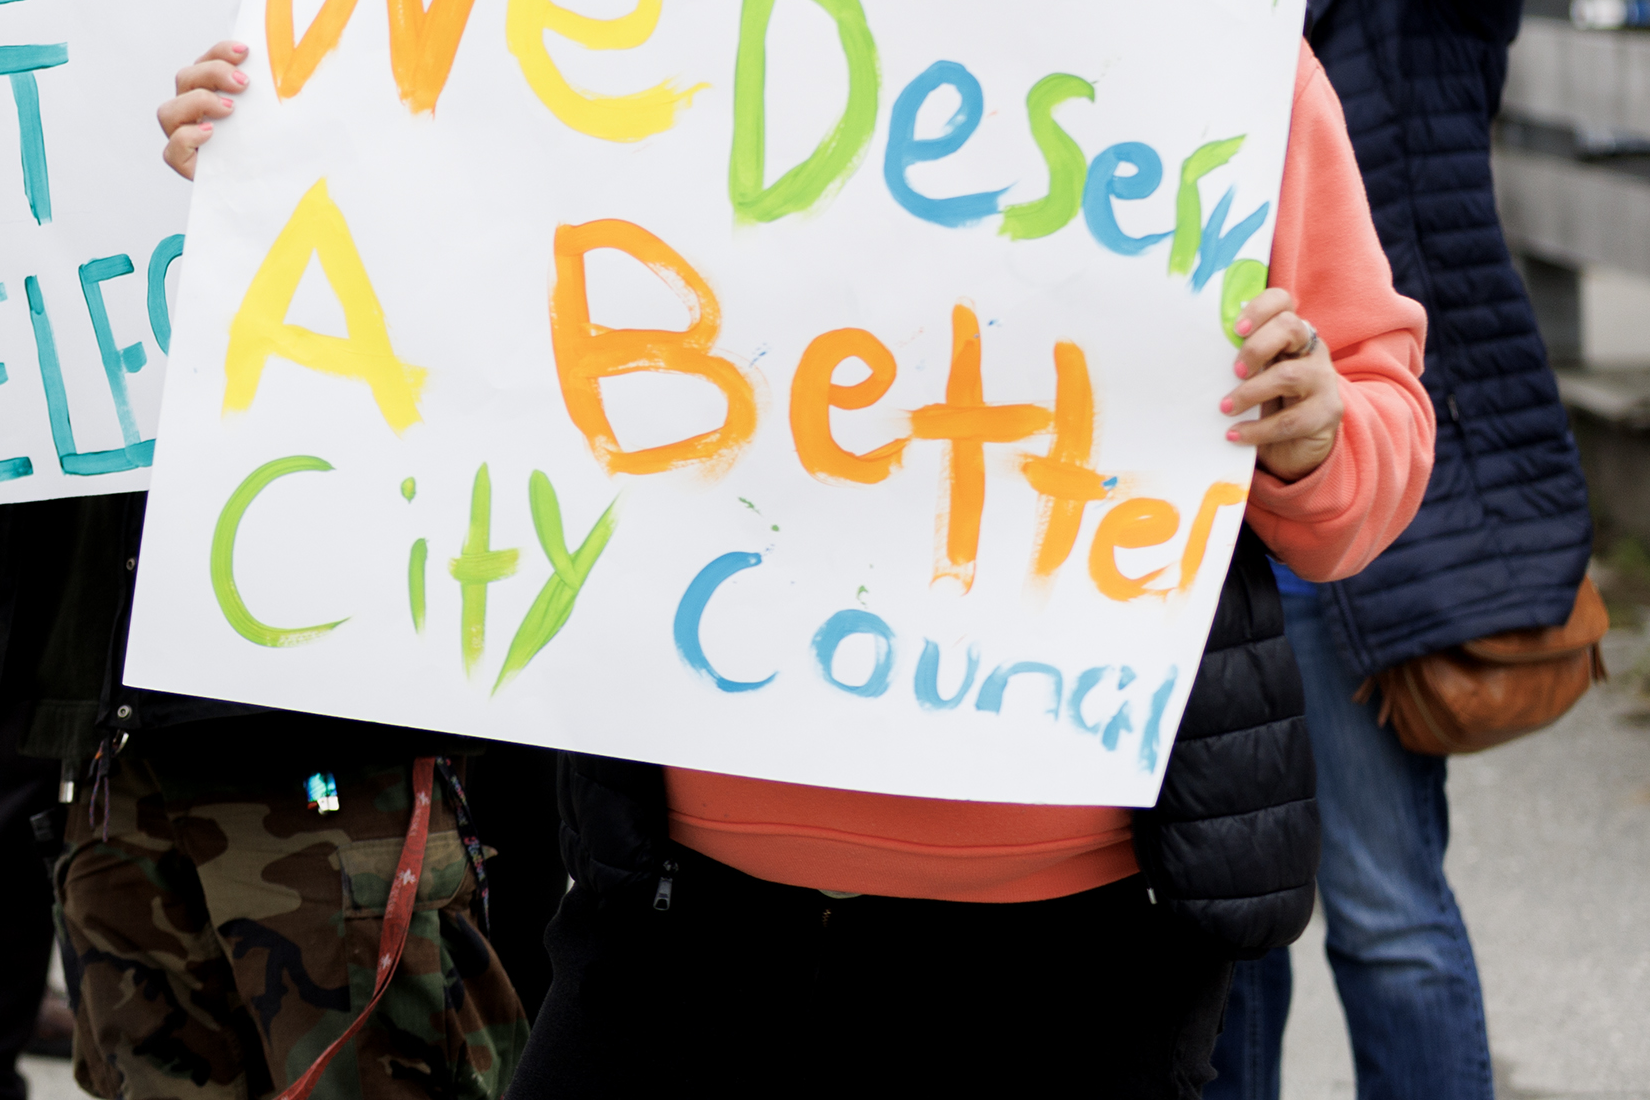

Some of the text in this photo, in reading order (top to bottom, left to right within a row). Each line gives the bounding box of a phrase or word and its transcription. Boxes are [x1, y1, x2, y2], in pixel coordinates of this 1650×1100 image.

[222, 178, 1248, 603] A Better
[211, 455, 1180, 777] City Council
